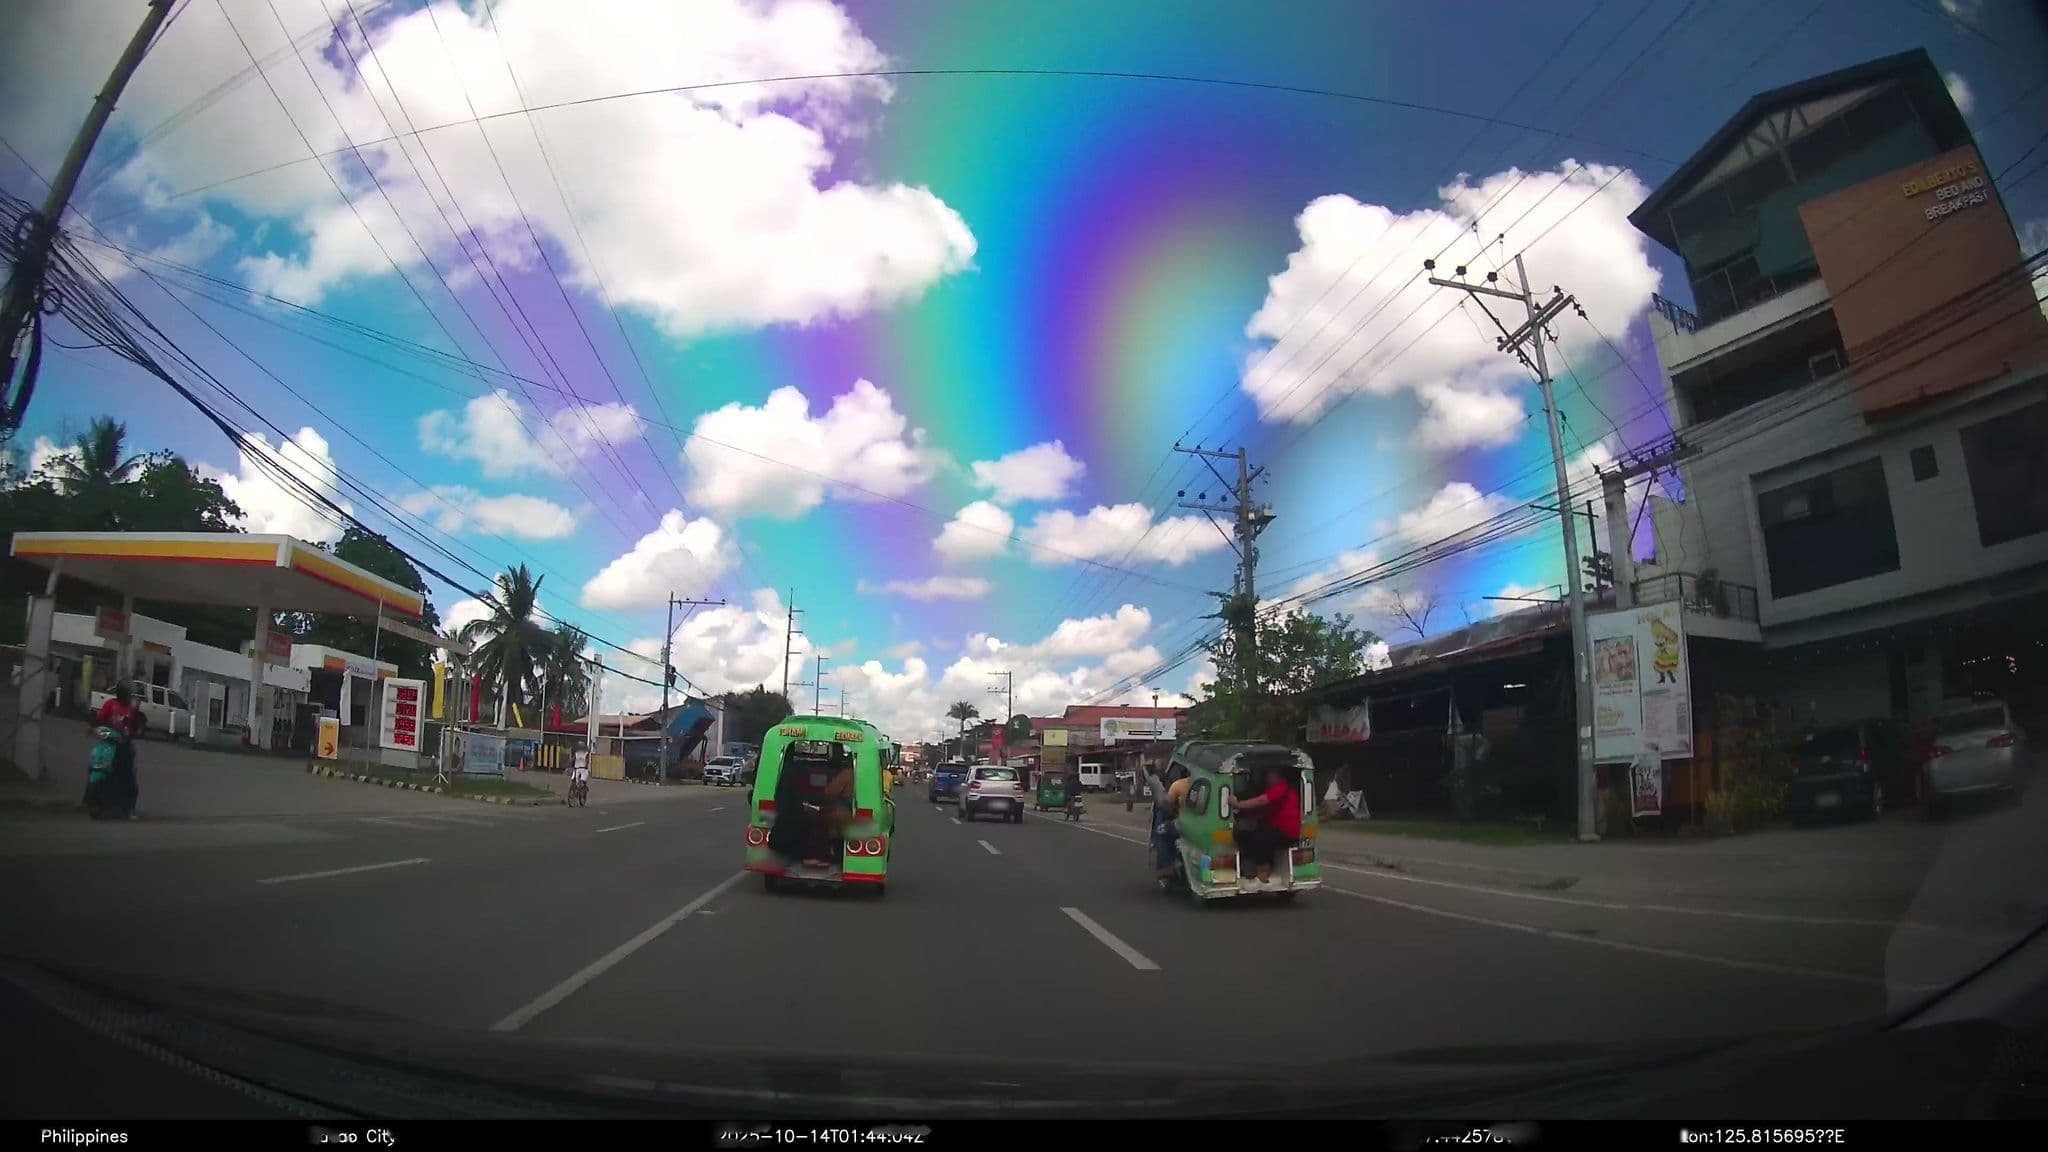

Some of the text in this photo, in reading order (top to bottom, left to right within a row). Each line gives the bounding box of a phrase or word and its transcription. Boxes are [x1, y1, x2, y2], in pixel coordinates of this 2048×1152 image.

[1936, 176, 1984, 201] BED AND
[1925, 190, 1988, 220] BREAKFAST
